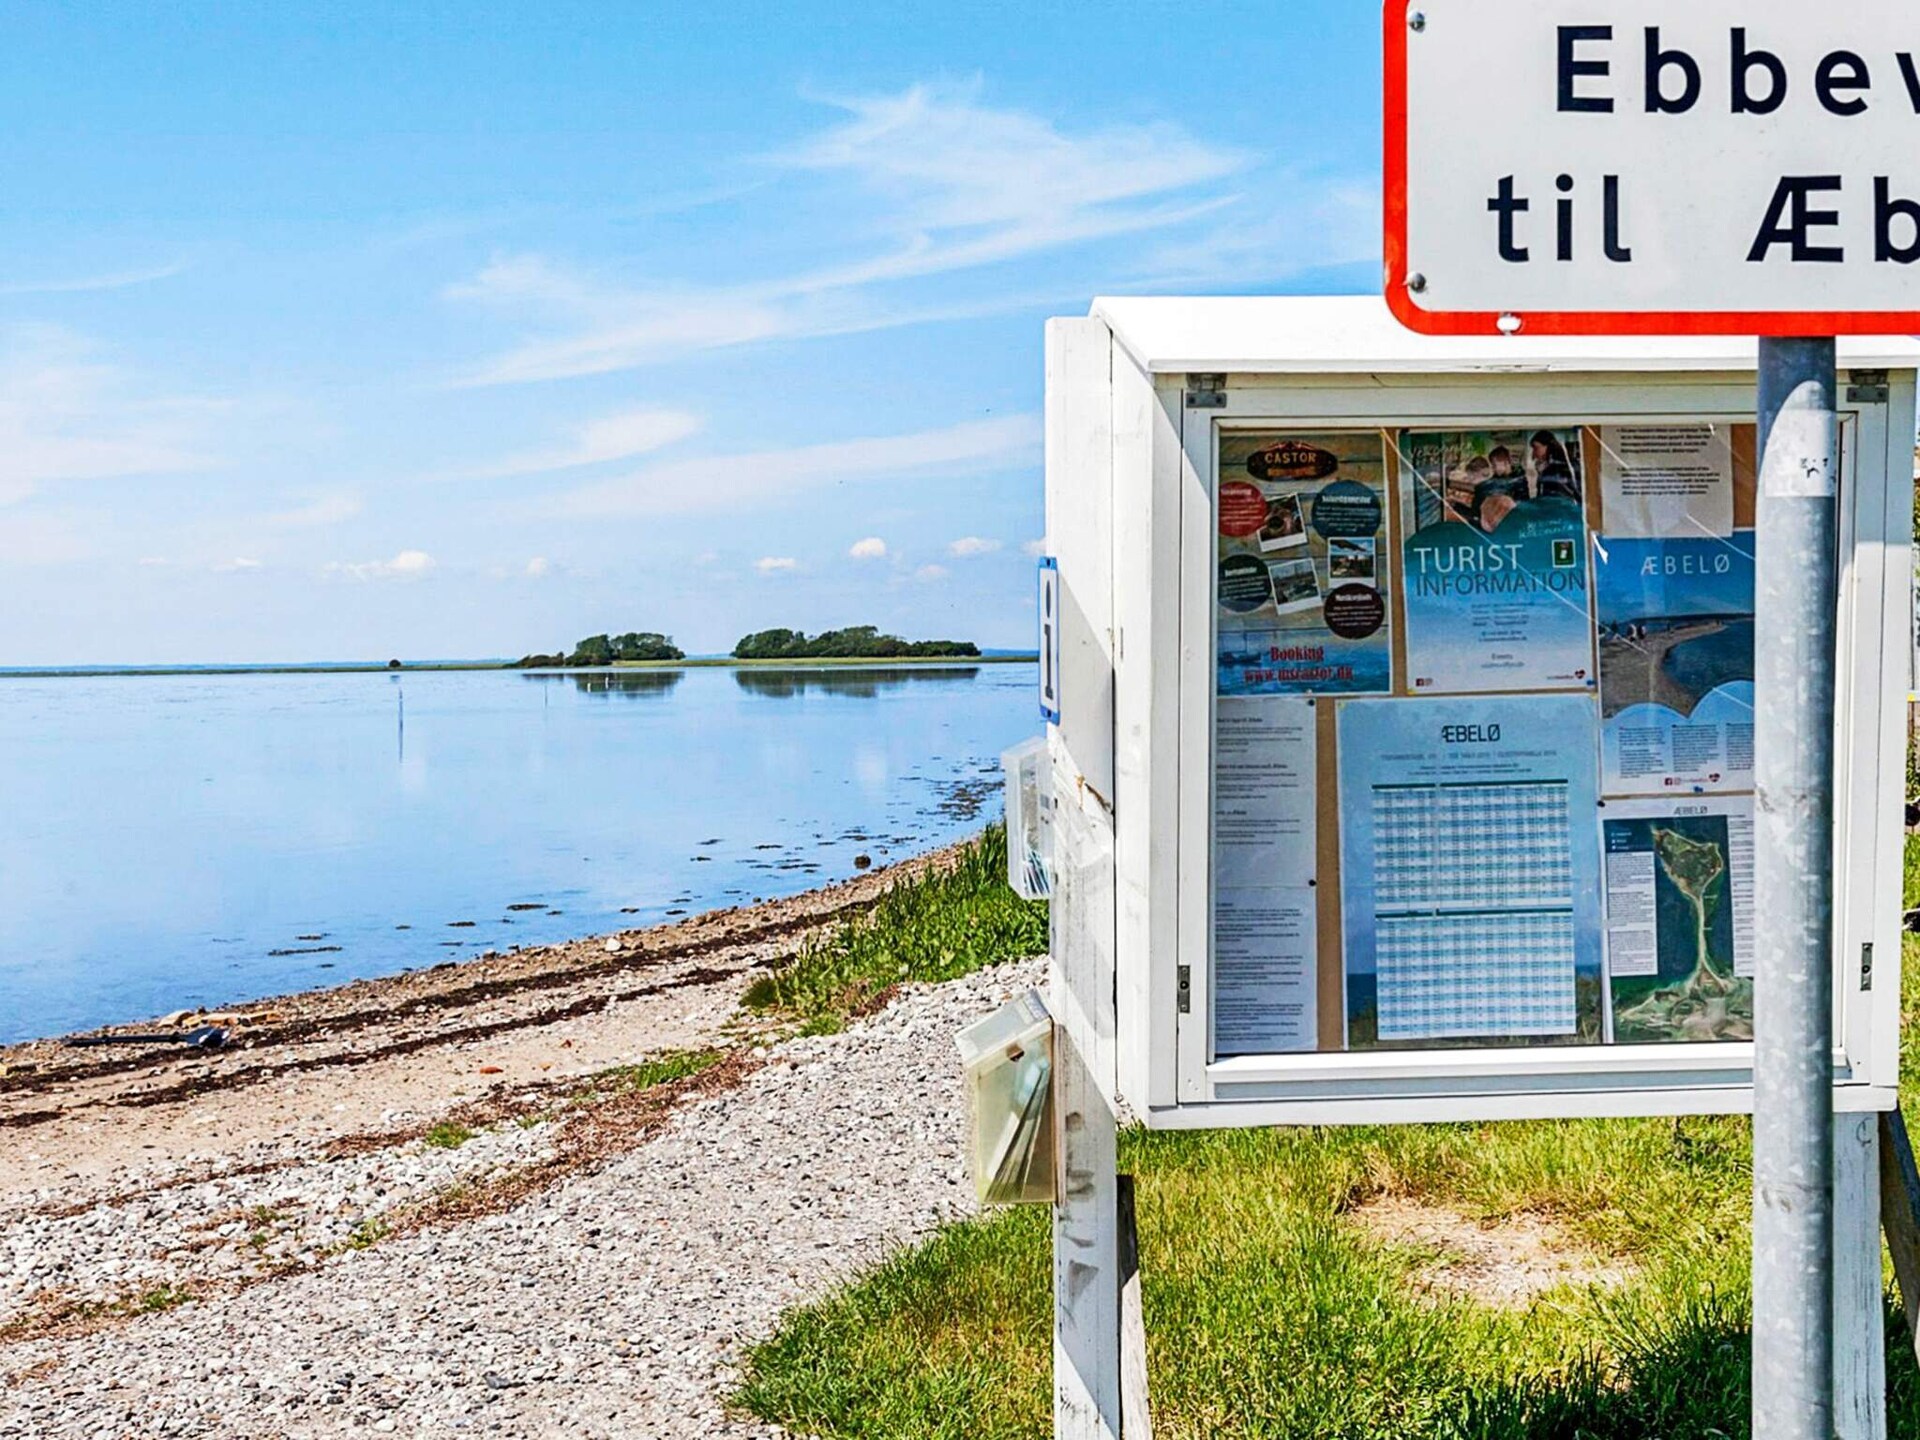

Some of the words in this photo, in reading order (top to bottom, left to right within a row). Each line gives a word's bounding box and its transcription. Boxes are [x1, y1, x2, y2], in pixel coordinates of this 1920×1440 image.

[1487, 174, 1632, 263] til
[1264, 452, 1317, 464] CASTOR
[1414, 543, 1523, 574] TURIST
[1641, 554, 1730, 576] ÆBELØ
[1415, 569, 1586, 597] INFORMATION
[1270, 645, 1324, 661] Booking
[1442, 724, 1501, 743] ÆBELØ
